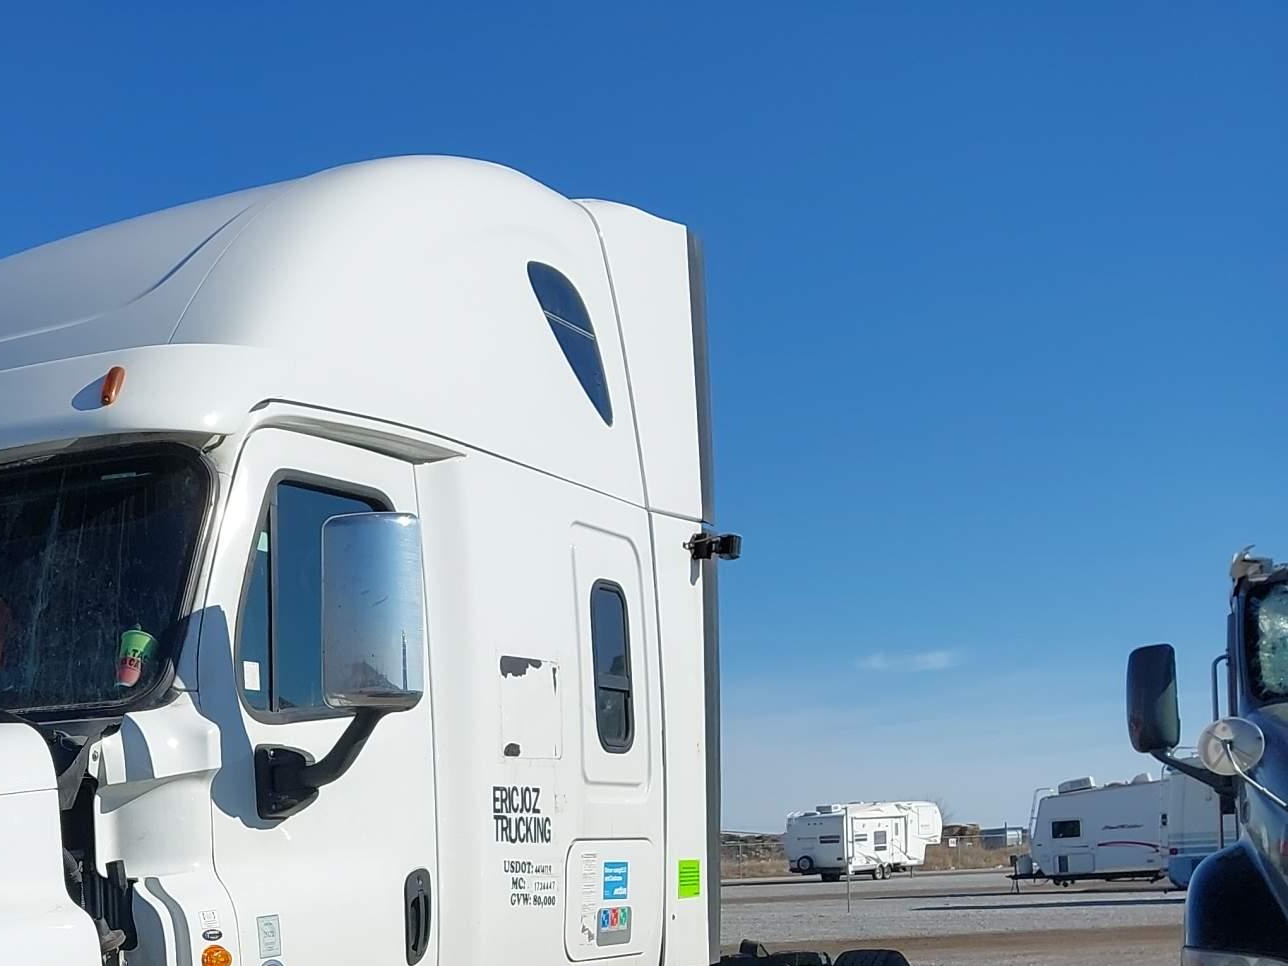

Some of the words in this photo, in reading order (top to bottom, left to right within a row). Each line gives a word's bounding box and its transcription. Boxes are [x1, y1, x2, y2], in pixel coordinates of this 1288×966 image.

[493, 786, 541, 813] ERICJOZ
[493, 815, 551, 843] TRUCKING
[503, 860, 533, 874] USDOT:
[511, 877, 525, 890] MC:
[510, 893, 531, 906] GVW:
[533, 894, 556, 908] 80,000
